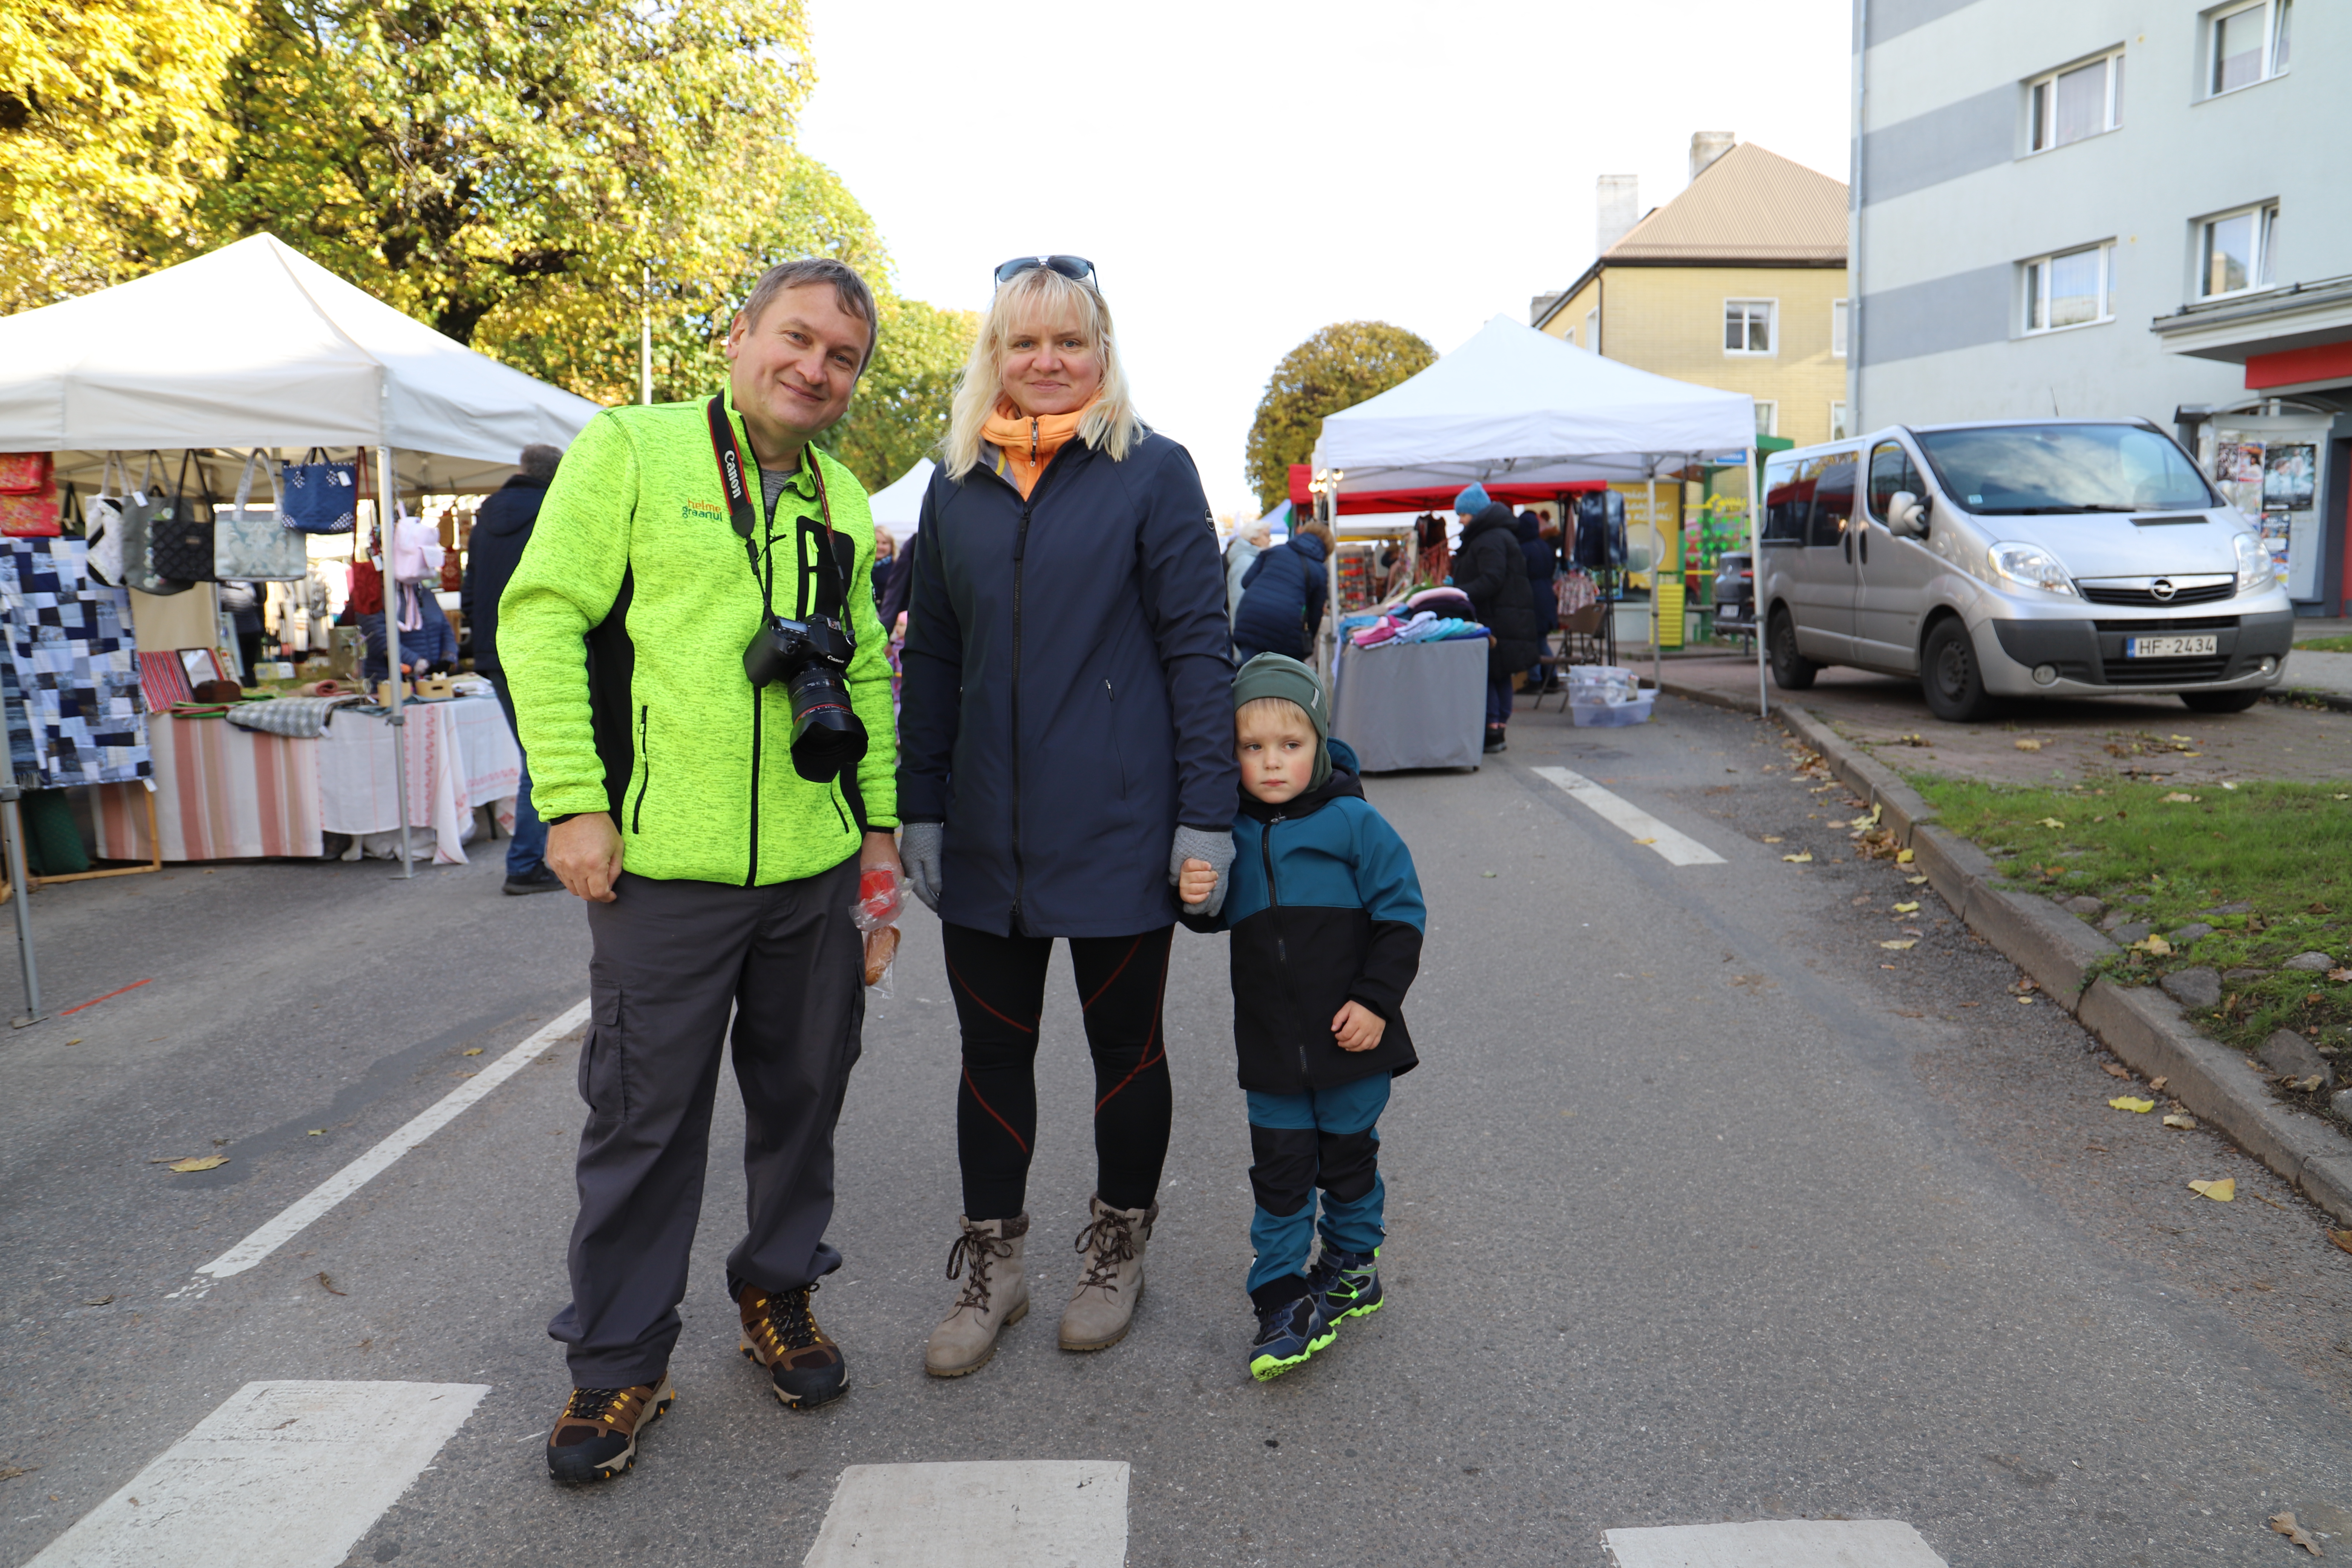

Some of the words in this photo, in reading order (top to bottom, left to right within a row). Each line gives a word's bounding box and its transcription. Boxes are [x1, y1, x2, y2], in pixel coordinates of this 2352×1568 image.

[724, 450, 741, 499] Canon
[688, 498, 721, 513] helme
[682, 506, 722, 522] graanul
[827, 655, 845, 663] Canon
